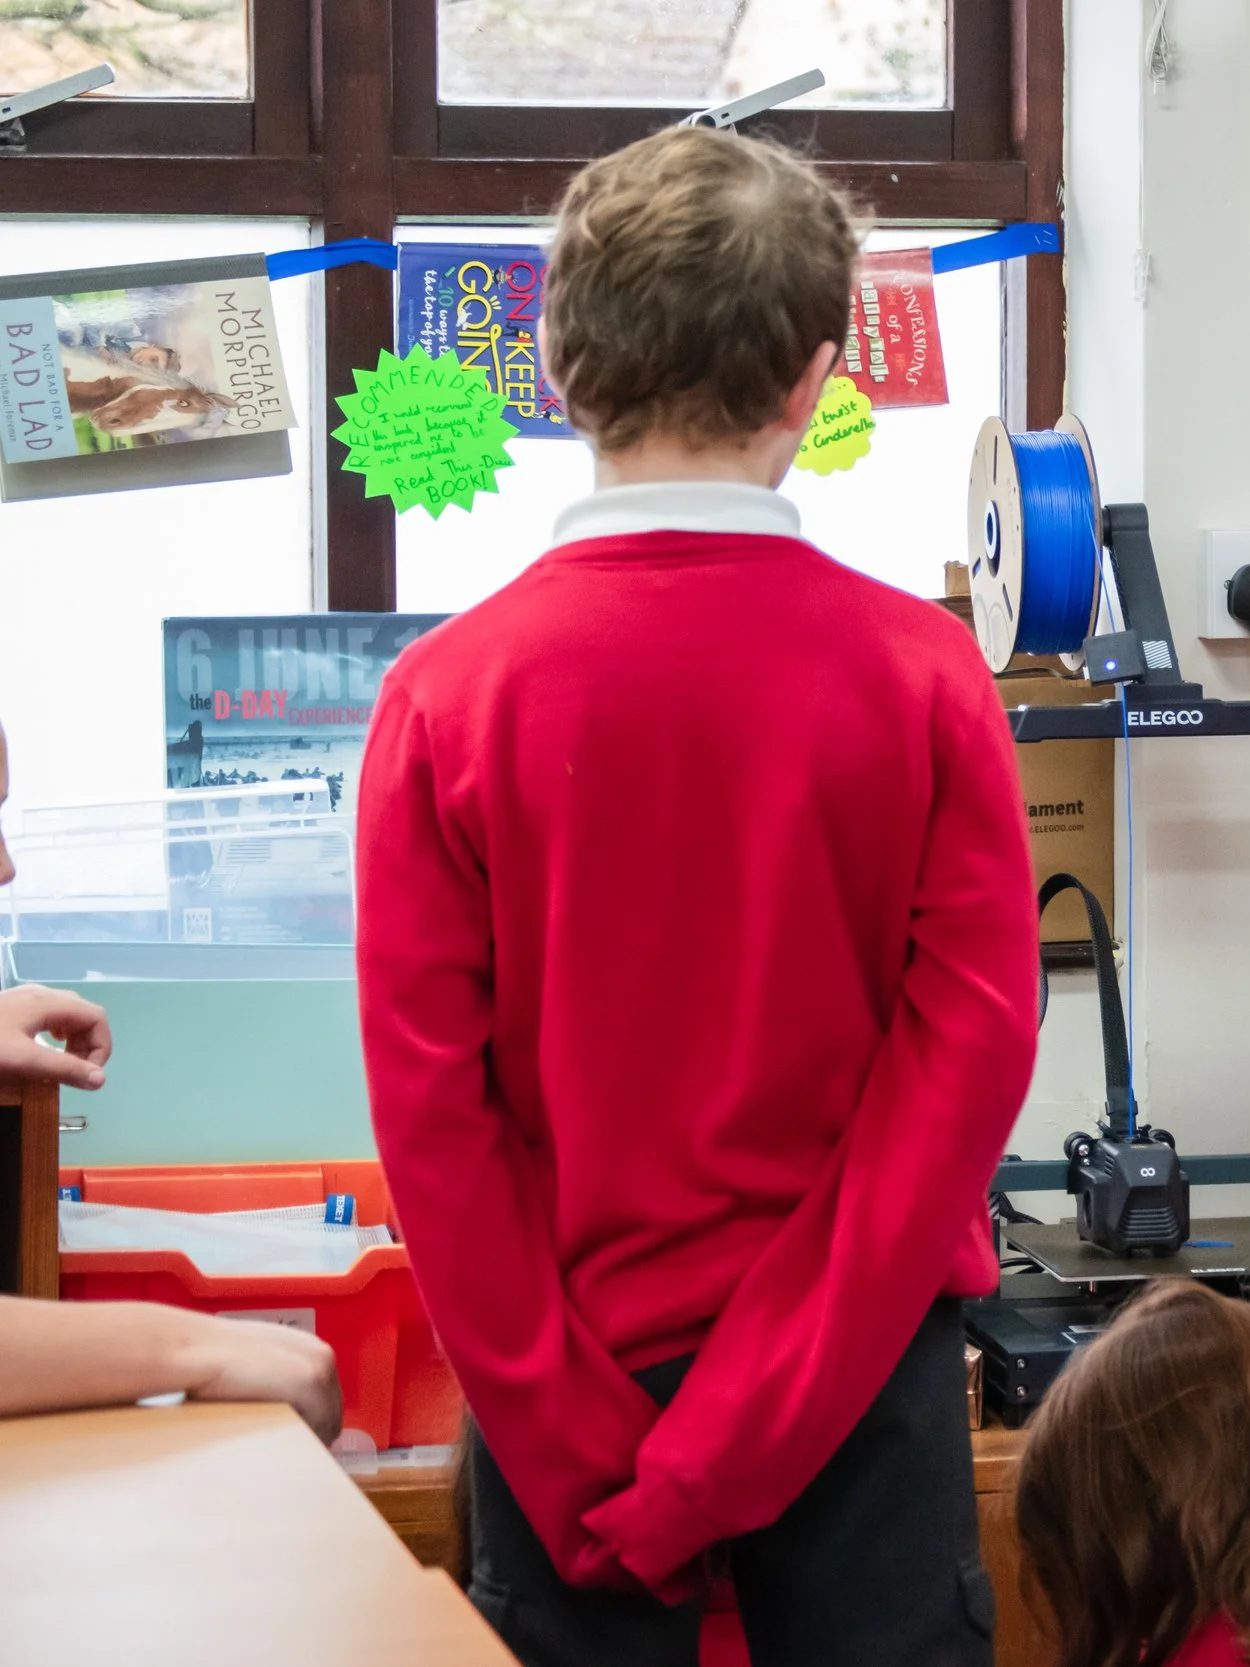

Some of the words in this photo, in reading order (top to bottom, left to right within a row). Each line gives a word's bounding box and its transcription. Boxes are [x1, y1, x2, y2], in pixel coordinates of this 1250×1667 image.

[424, 269, 438, 294] the
[505, 261, 537, 321] ON
[421, 296, 438, 319] top
[421, 321, 437, 339] of
[456, 260, 493, 393] GOIN
[886, 314, 903, 331] of
[889, 334, 902, 345] a
[6, 322, 41, 387] BAD
[41, 343, 54, 369] NOT
[215, 291, 262, 430] MORPURGO
[242, 308, 282, 418] MICHAEL
[46, 374, 58, 396] BAD
[504, 341, 536, 418] KEEP
[50, 401, 62, 421] FOR
[348, 366, 499, 468] RECOMMENDED
[18, 400, 54, 451] LAD
[56, 424, 65, 432] A
[394, 467, 435, 495] Read
[176, 627, 213, 701] 6
[235, 626, 375, 701] JUNE
[190, 692, 212, 711] the
[214, 688, 289, 720] D-DAY
[288, 706, 373, 726] EXPERIENCE
[1127, 709, 1203, 727] ELEGOO
